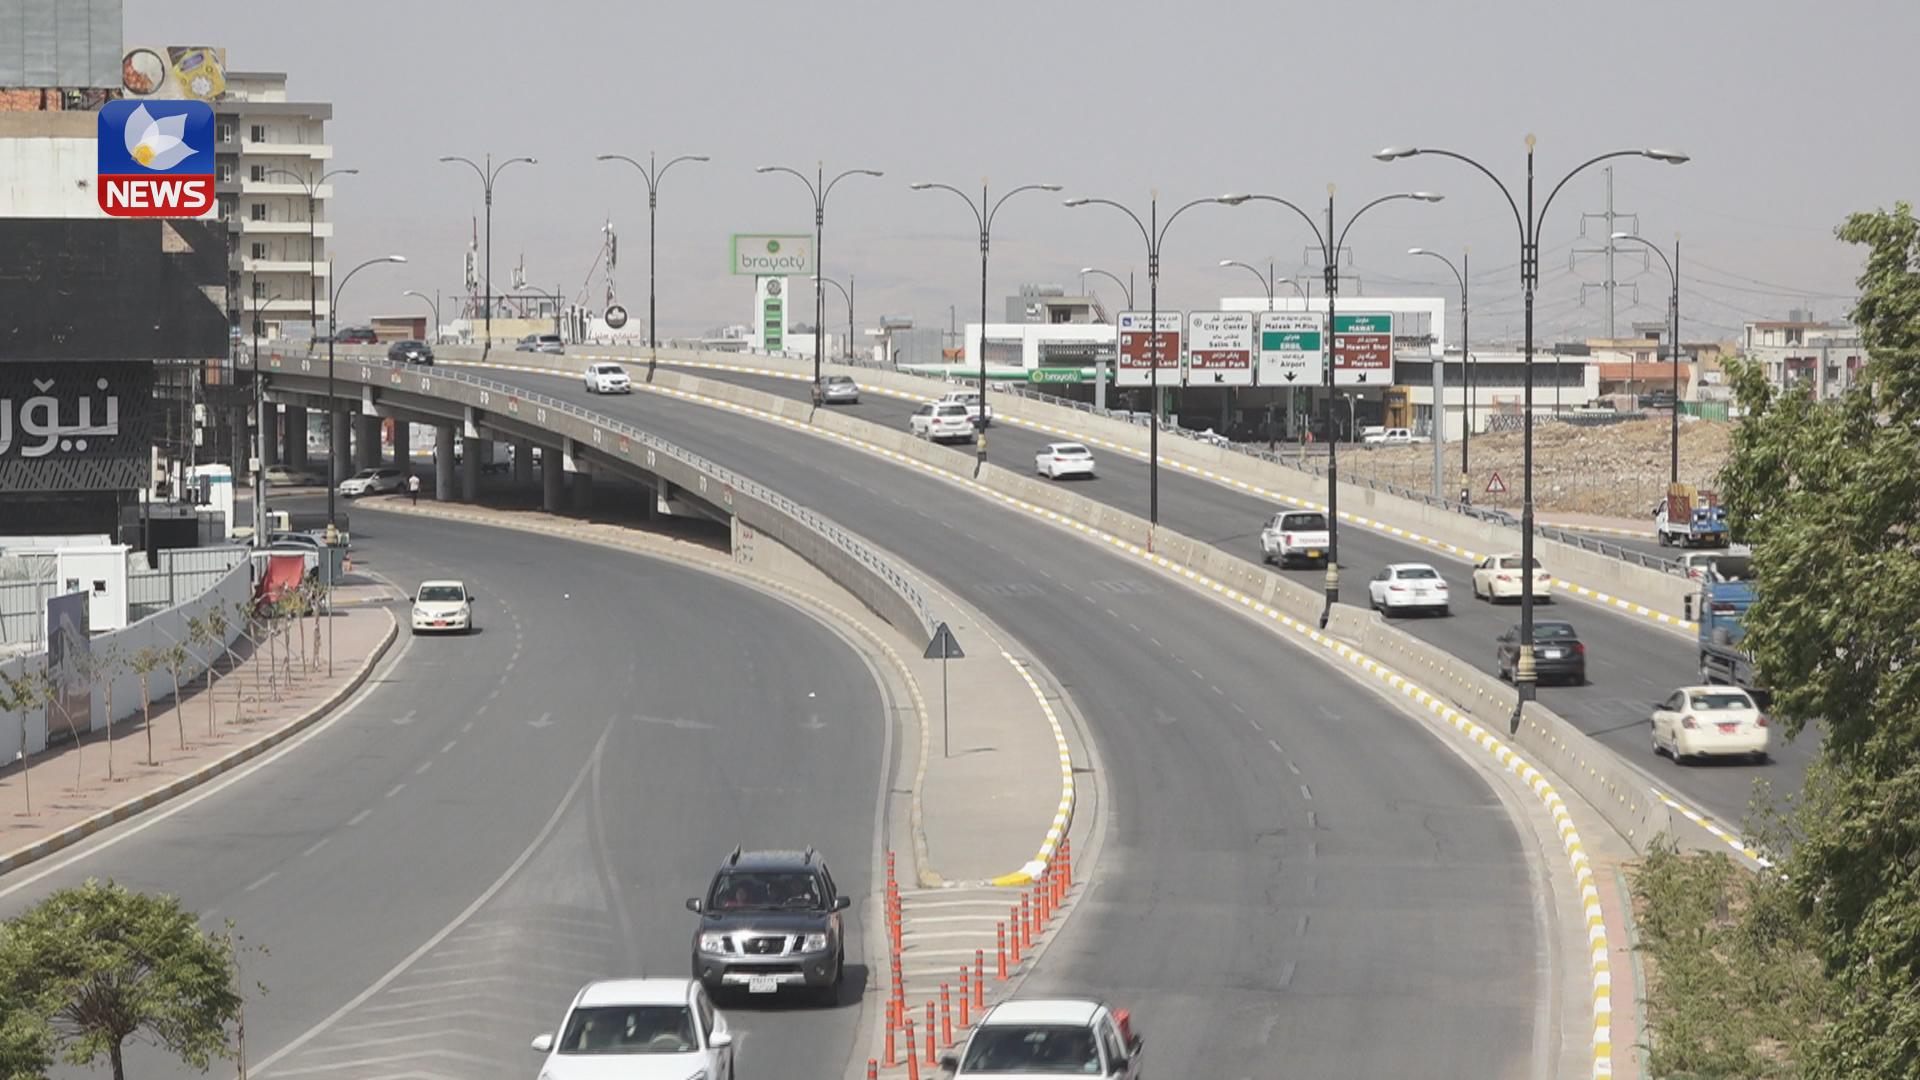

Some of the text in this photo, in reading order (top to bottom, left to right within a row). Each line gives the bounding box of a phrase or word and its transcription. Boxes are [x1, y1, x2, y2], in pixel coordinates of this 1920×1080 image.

[742, 254, 805, 271] brayaty
[1204, 323, 1248, 331] City Center
[1158, 359, 1177, 367] Land
[1280, 360, 1306, 368] Airport
